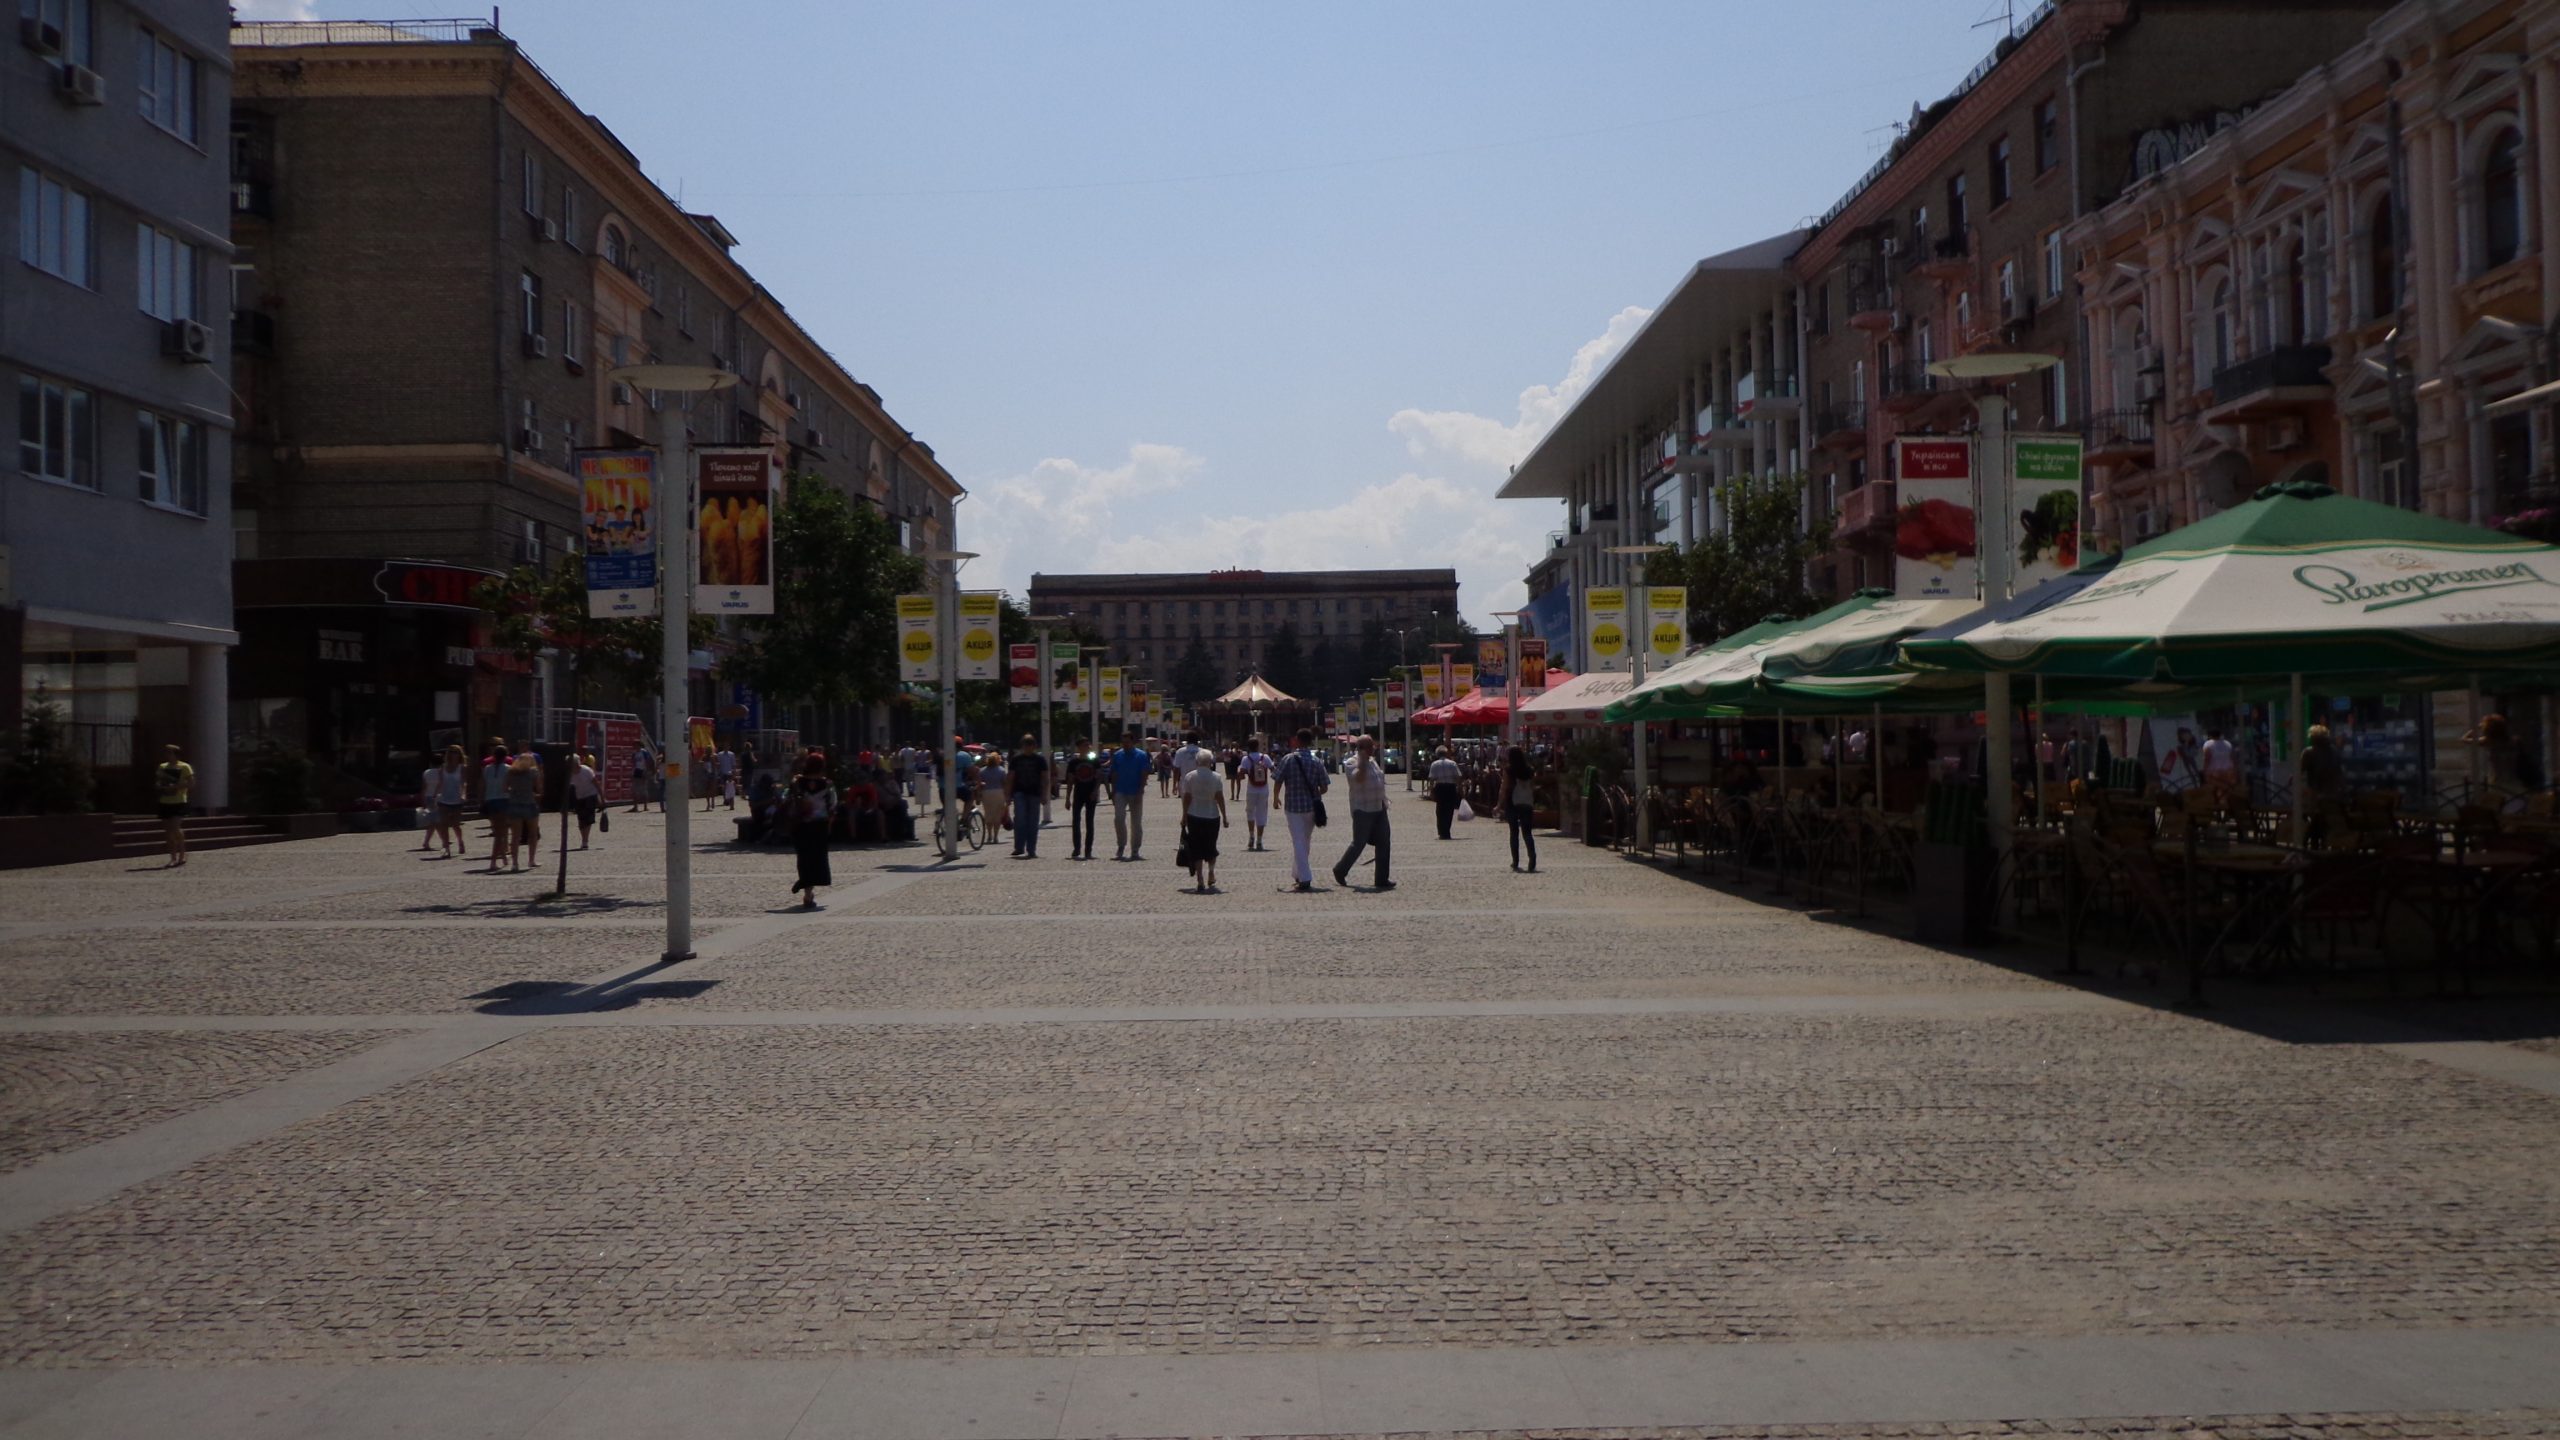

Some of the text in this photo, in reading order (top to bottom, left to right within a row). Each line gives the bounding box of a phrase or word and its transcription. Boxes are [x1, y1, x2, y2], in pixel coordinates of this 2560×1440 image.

[2292, 562, 2543, 606] Staropramen
[1594, 634, 1621, 645] АКЦІЯ
[1654, 633, 1680, 644] АКЦІЯ
[318, 640, 364, 662] BAR
[445, 646, 475, 667] PUB
